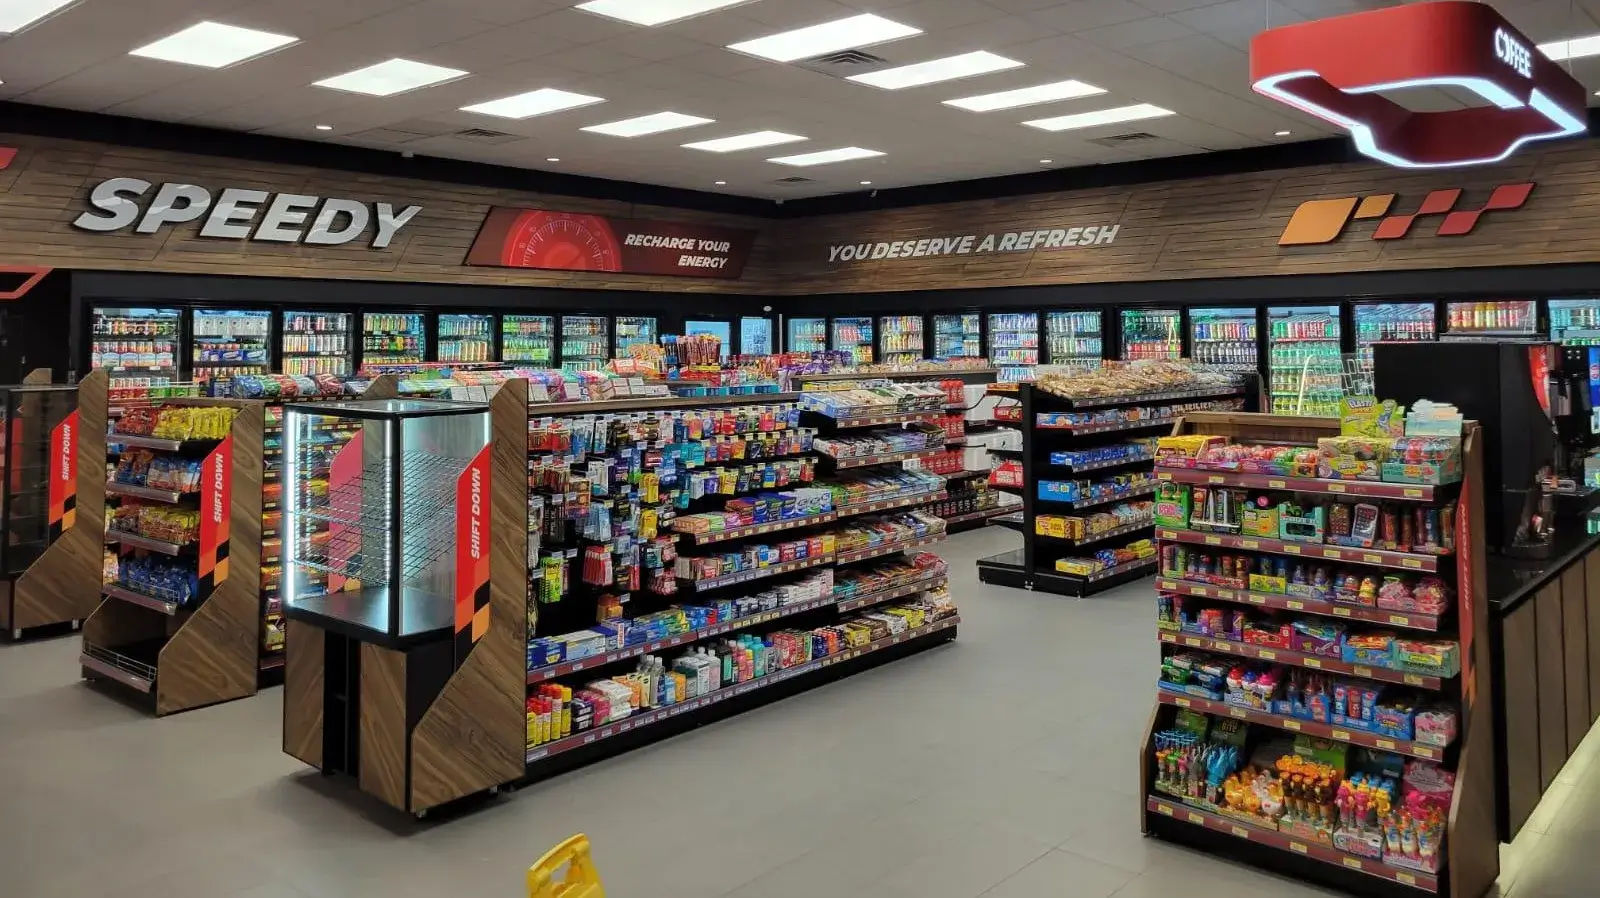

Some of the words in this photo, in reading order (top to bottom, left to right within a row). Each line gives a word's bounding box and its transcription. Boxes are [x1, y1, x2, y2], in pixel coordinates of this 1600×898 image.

[1495, 26, 1532, 78] COFFEE
[72, 176, 423, 248] SPEEDY
[624, 233, 696, 250] RECHARGE
[698, 239, 731, 253] YOUR
[677, 254, 729, 269] ENERGY
[829, 243, 872, 262] YOU
[871, 235, 977, 260] DESERVE
[975, 233, 996, 253] A
[998, 224, 1121, 252] REFRESH
[63, 424, 71, 453] DOWN
[62, 454, 70, 481] SHIFT
[215, 453, 224, 490] DOWN
[214, 491, 223, 524] SHIFT
[471, 467, 481, 514] DOWN
[471, 516, 481, 560] SHIFT
